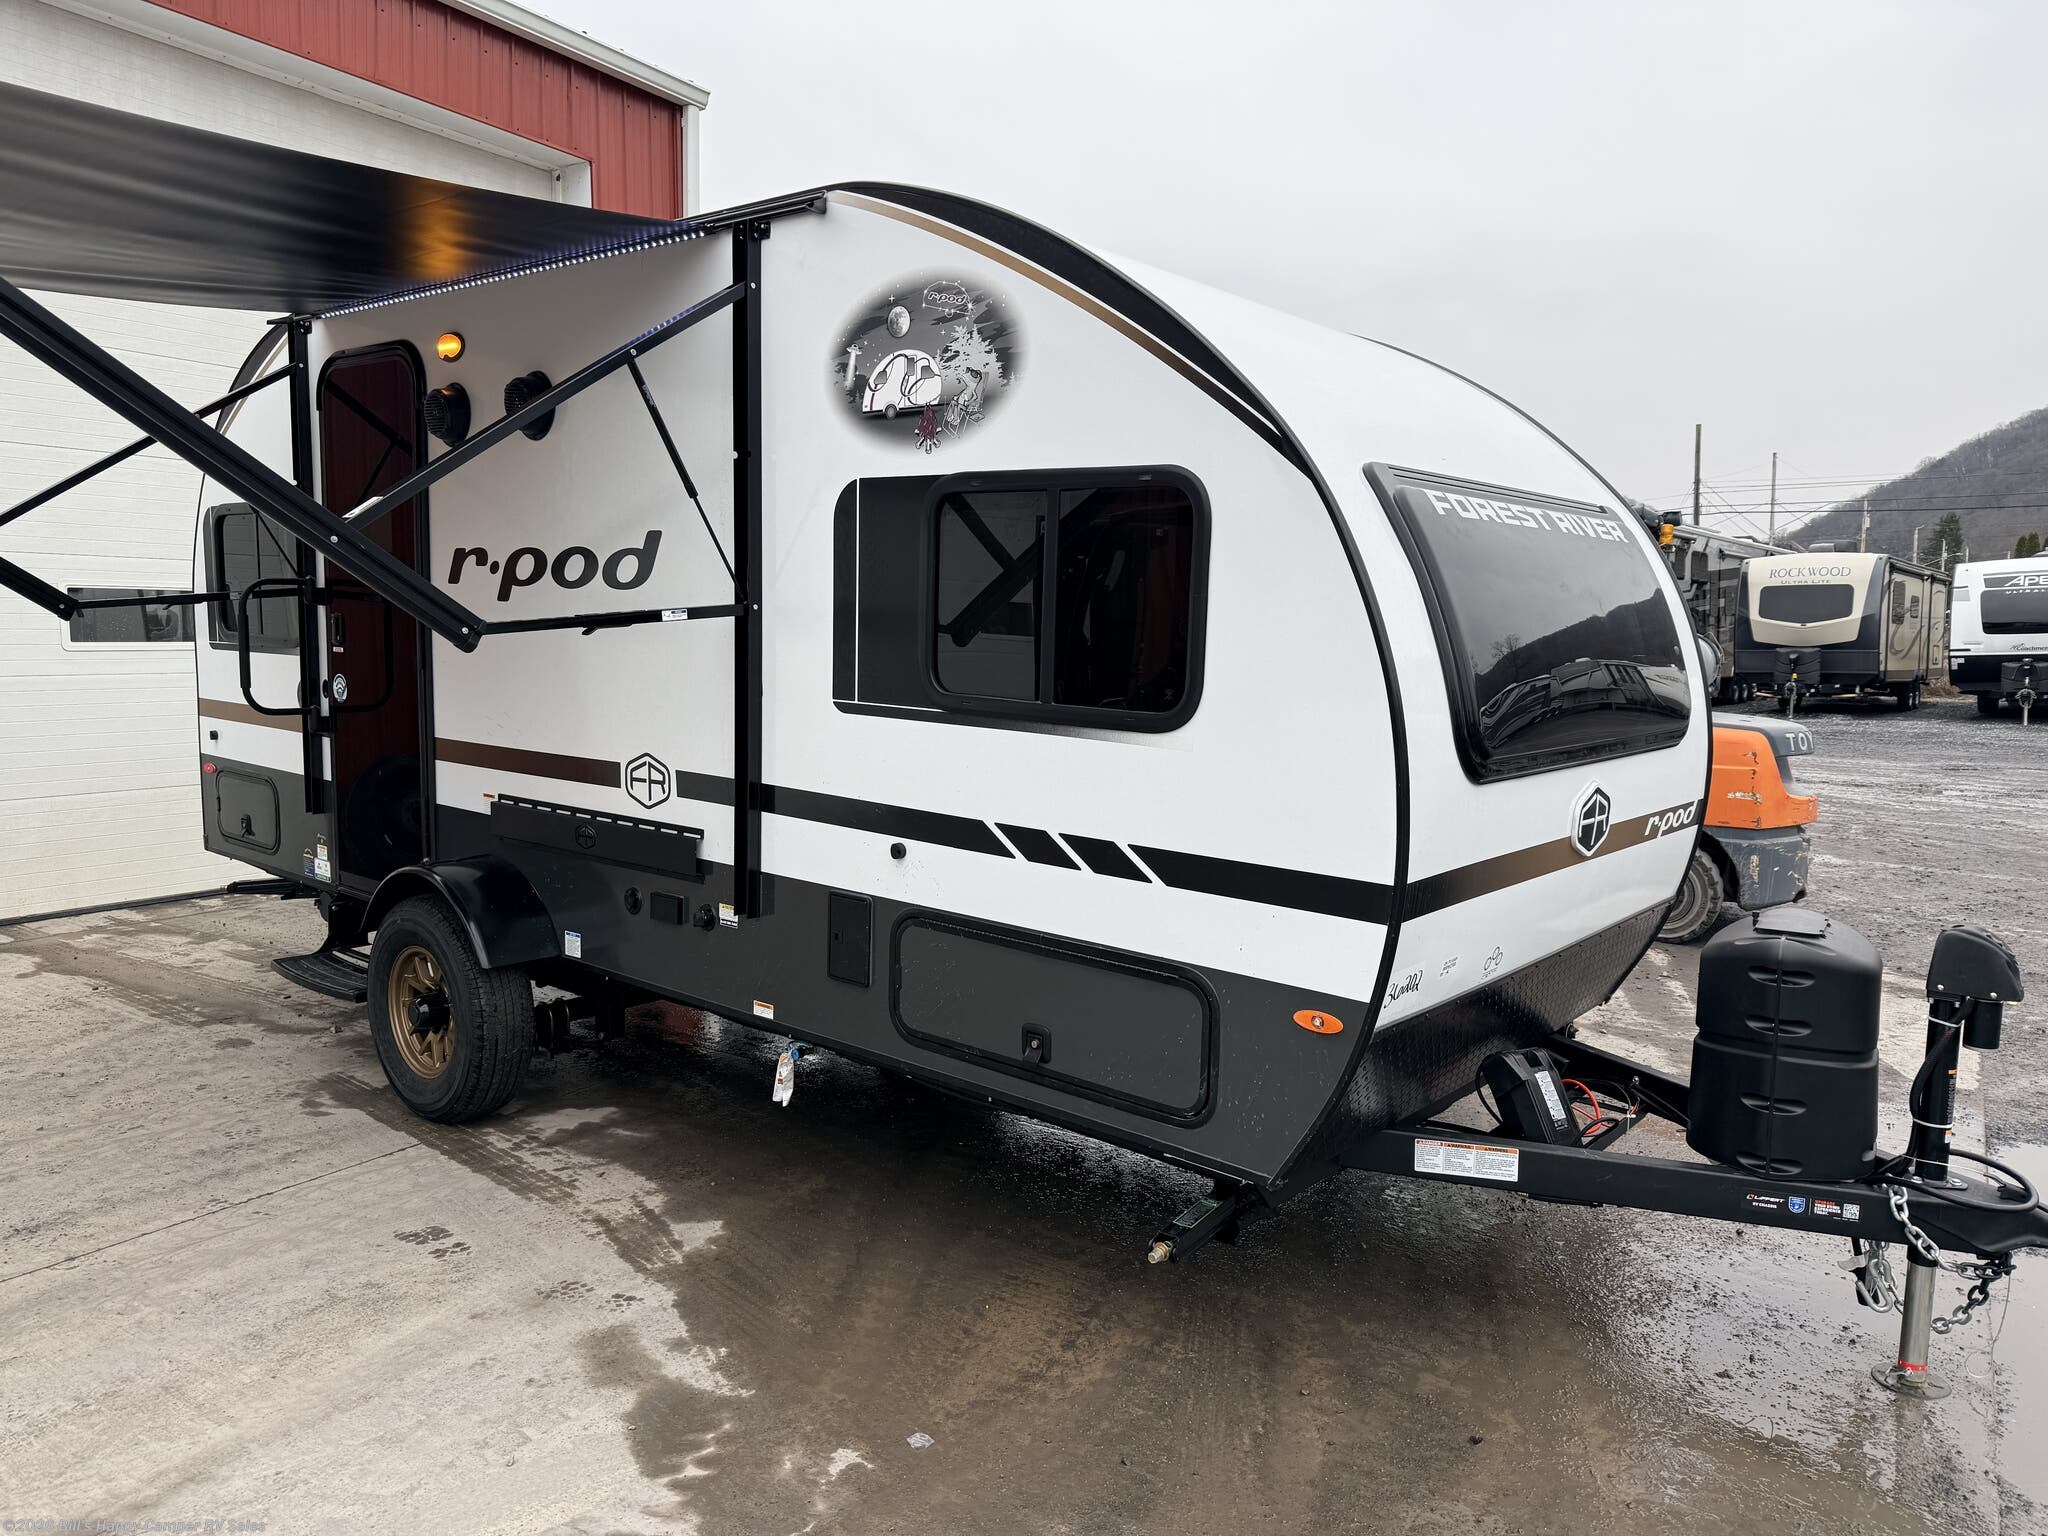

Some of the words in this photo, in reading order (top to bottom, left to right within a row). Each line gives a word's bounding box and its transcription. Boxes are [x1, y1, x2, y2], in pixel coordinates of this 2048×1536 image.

[1424, 490, 1551, 530] FOREST
[1549, 510, 1630, 543] RIVER
[1769, 566, 1852, 579] ROCKWOOD
